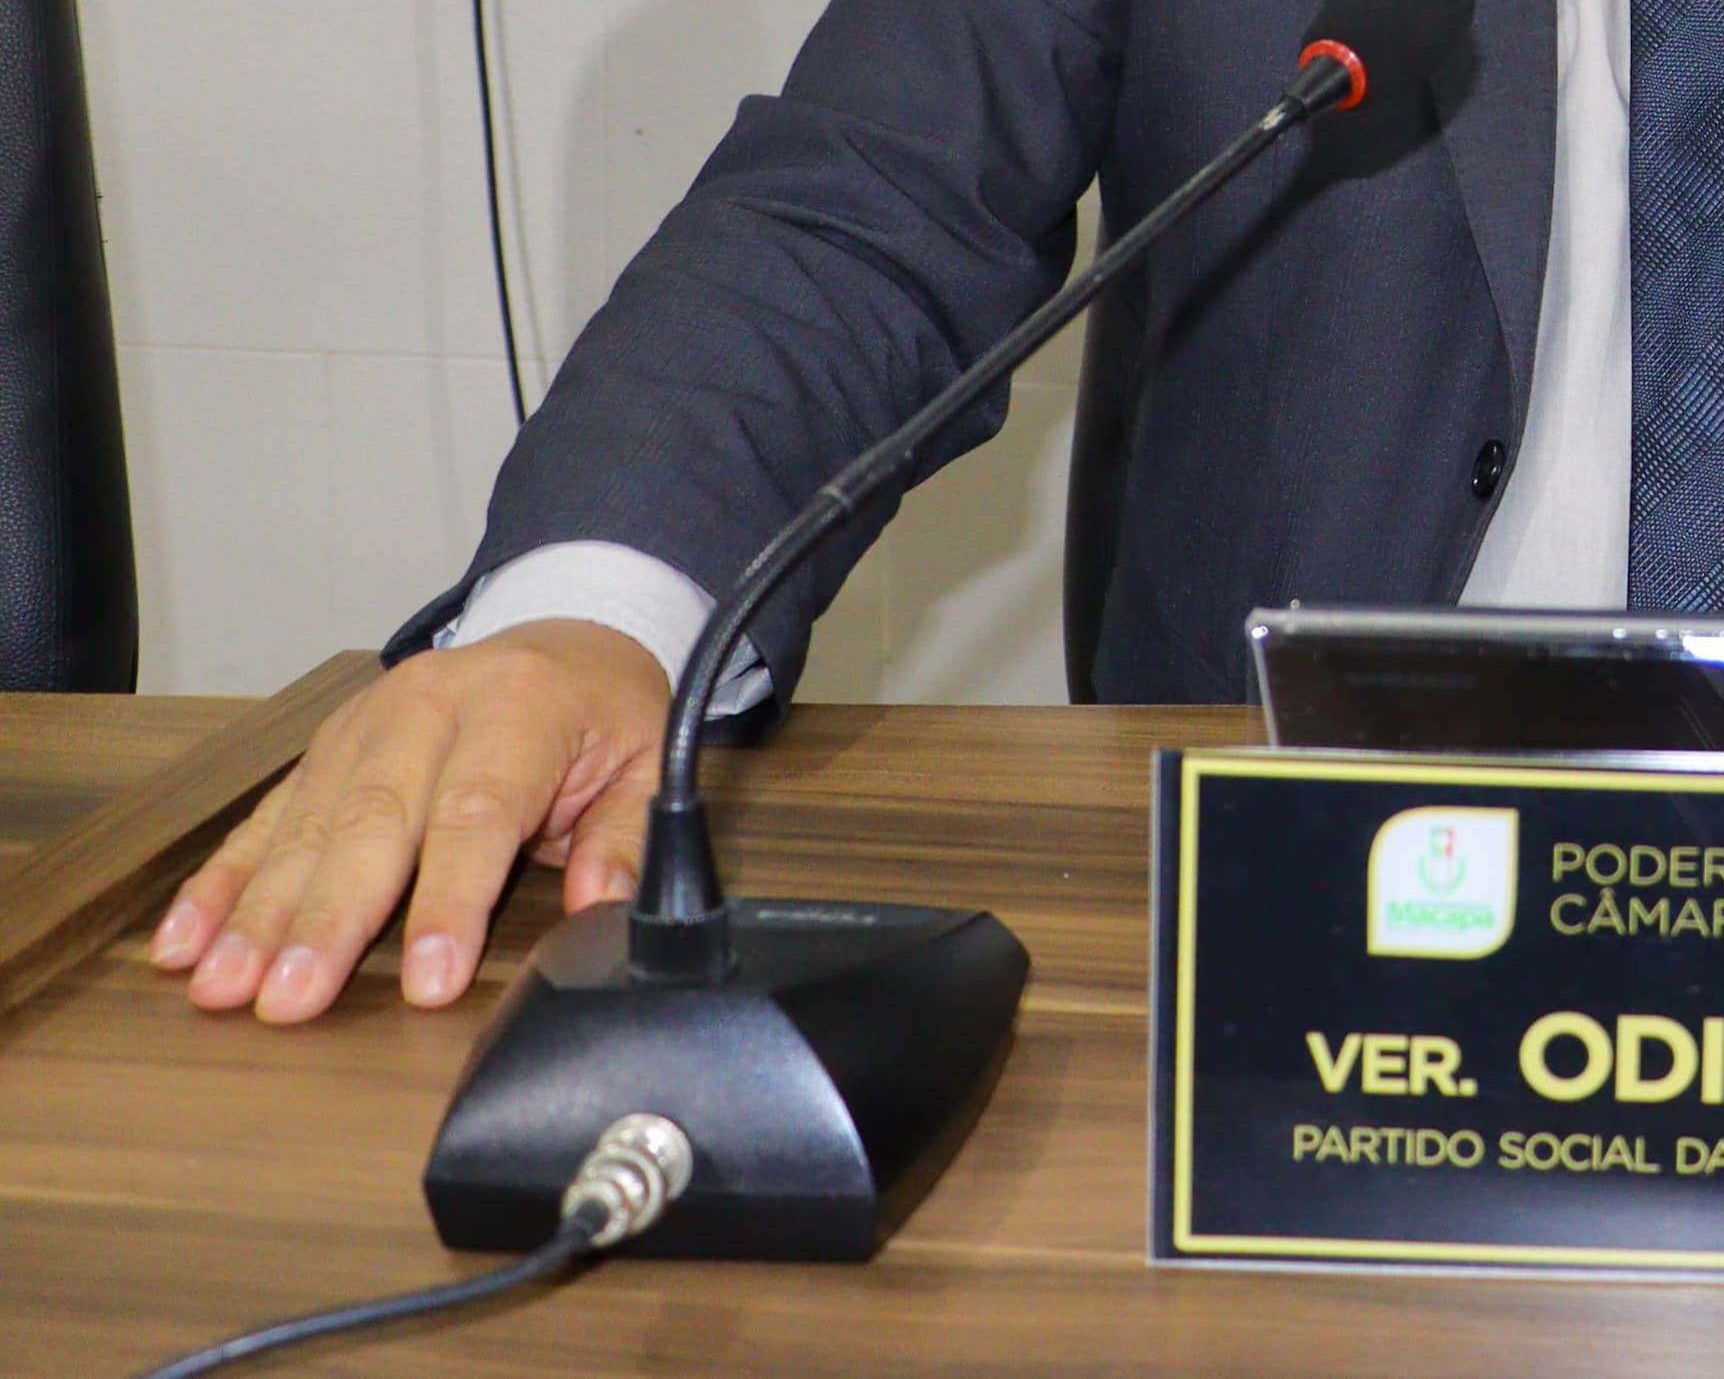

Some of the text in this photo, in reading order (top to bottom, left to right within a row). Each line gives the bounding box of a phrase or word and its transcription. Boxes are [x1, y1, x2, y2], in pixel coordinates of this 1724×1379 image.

[1306, 1032, 1477, 1097] VER.
[1293, 1125, 1484, 1168] PARTIDO
[1499, 1132, 1660, 1173] SOCIAL
